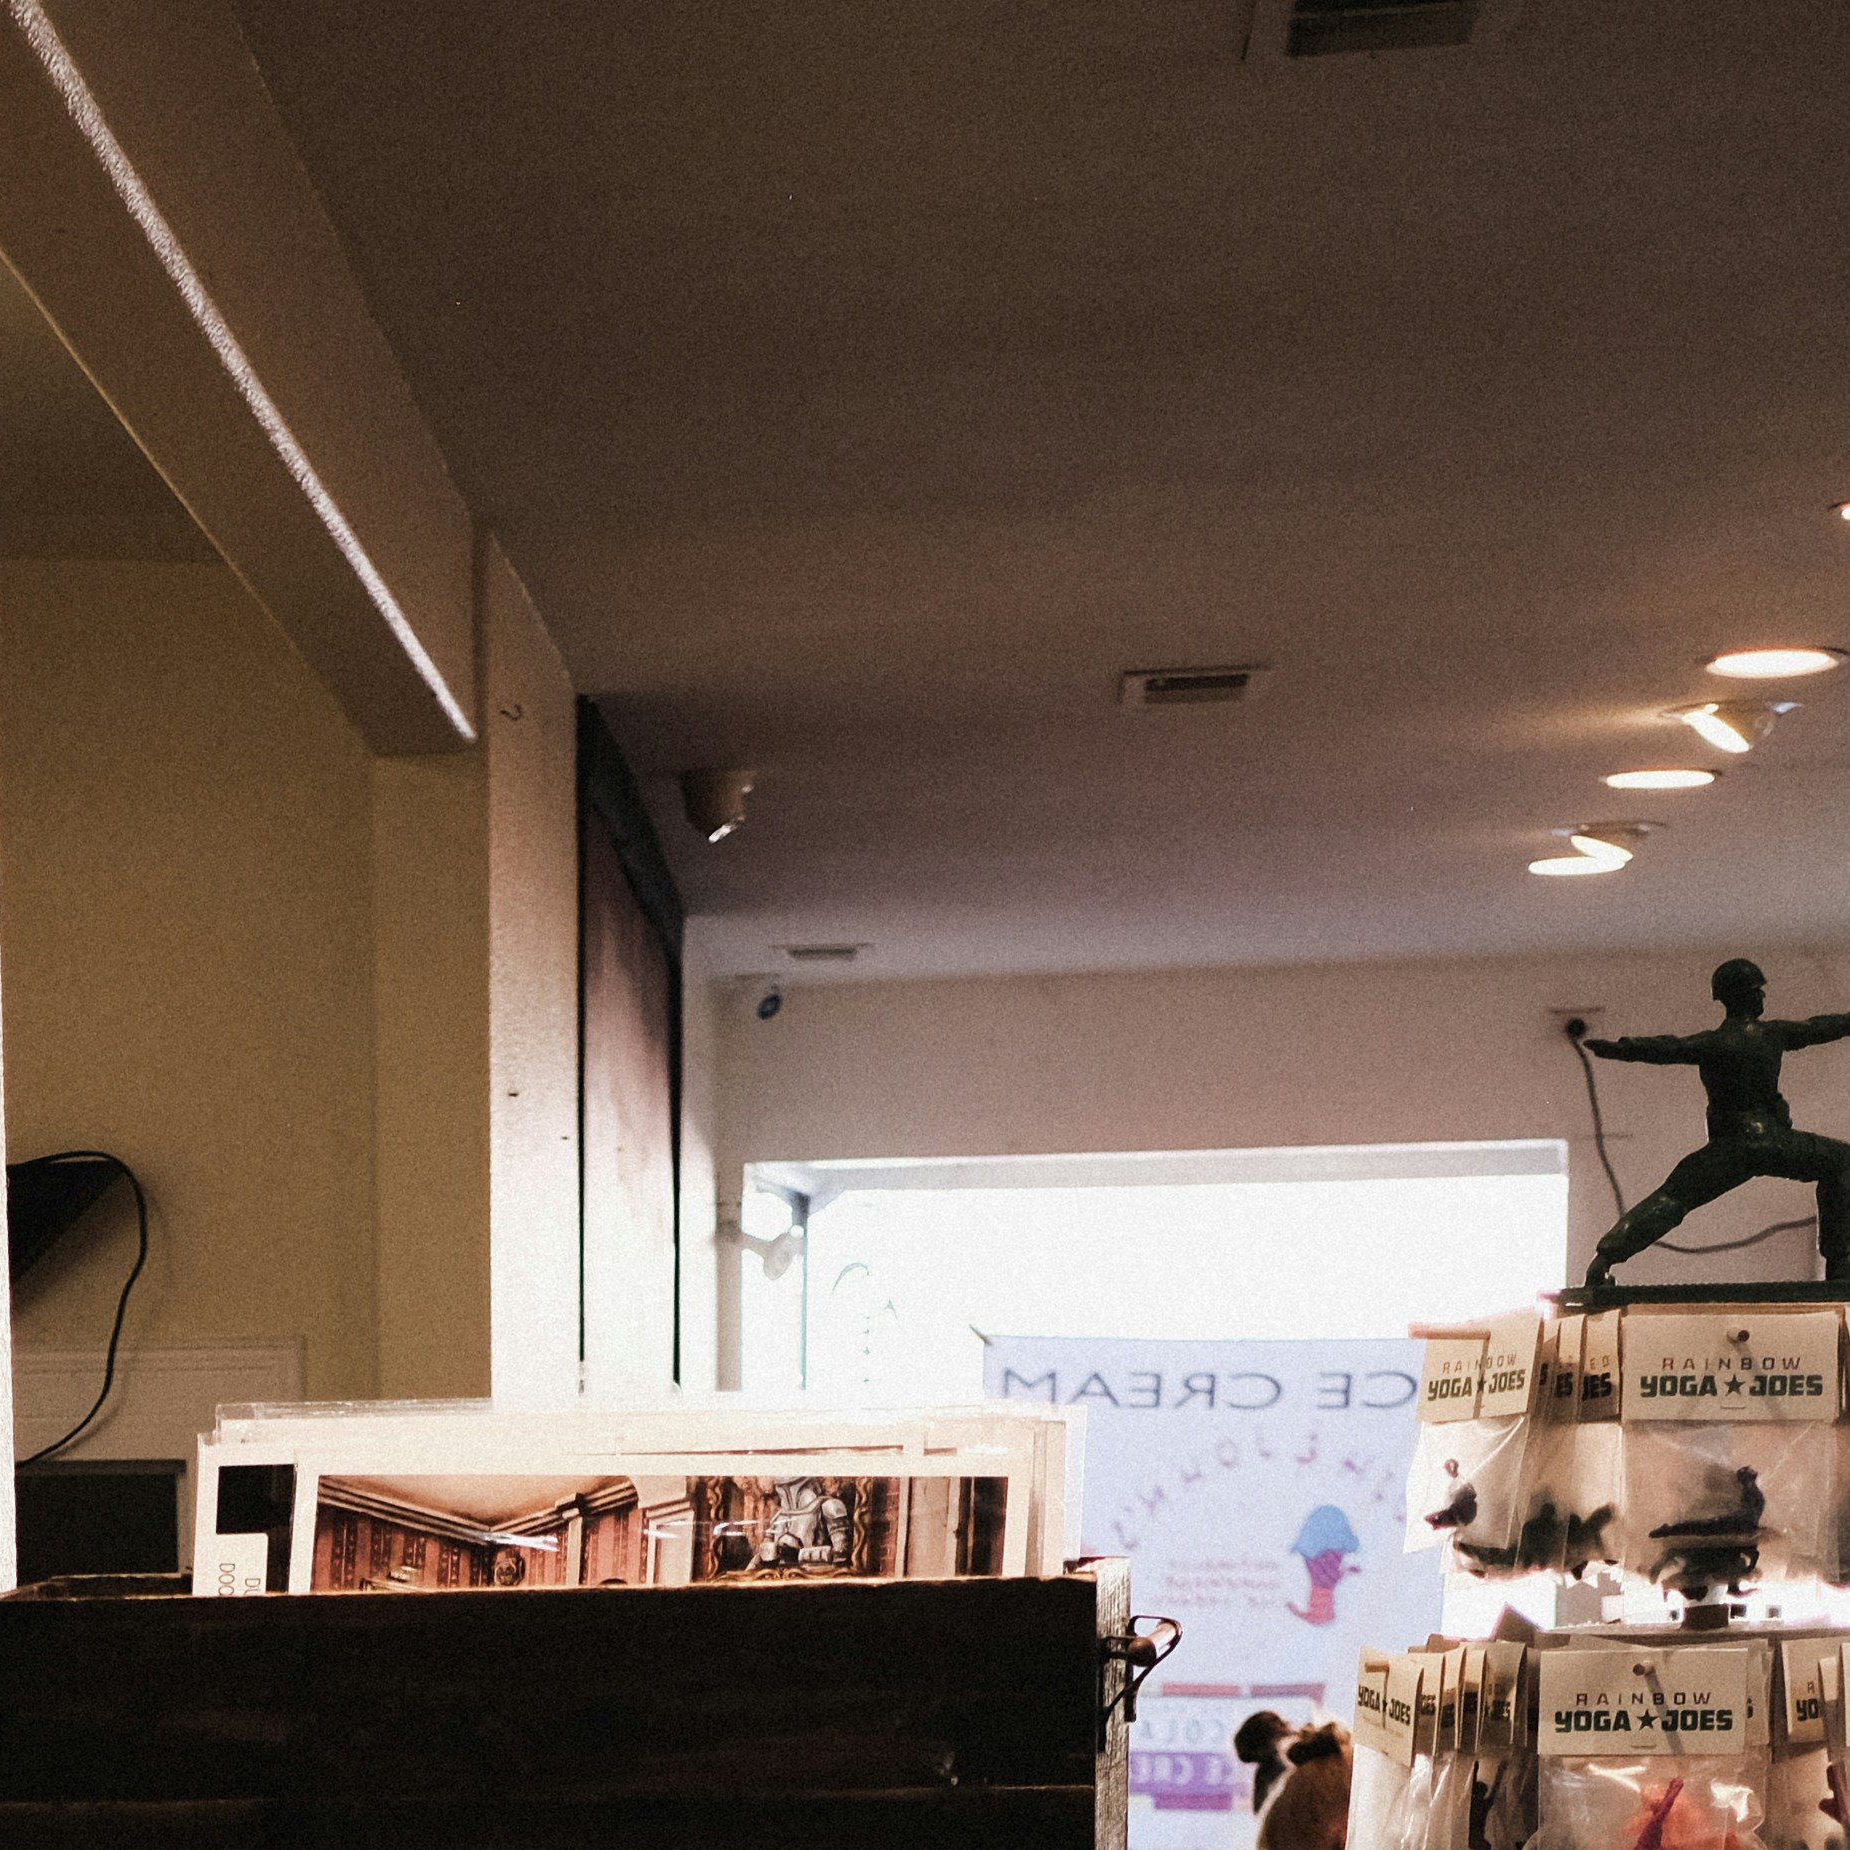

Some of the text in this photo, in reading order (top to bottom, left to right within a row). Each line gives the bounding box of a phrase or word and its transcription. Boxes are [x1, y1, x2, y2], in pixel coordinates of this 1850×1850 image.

[1442, 1354, 1517, 1374] RAINBOW
[1661, 1357, 1801, 1371] RAINBOW
[1428, 1376, 1472, 1401] YOGA
[1488, 1369, 1526, 1393] JOES
[1640, 1375, 1823, 1398] YOGA JOES
[1358, 1685, 1380, 1712] YOGA
[1388, 1698, 1411, 1726] JOES
[1576, 1692, 1711, 1706] RAINBOW
[1796, 1698, 1819, 1721] YO
[1555, 1709, 1733, 1733] YOGA JOES
